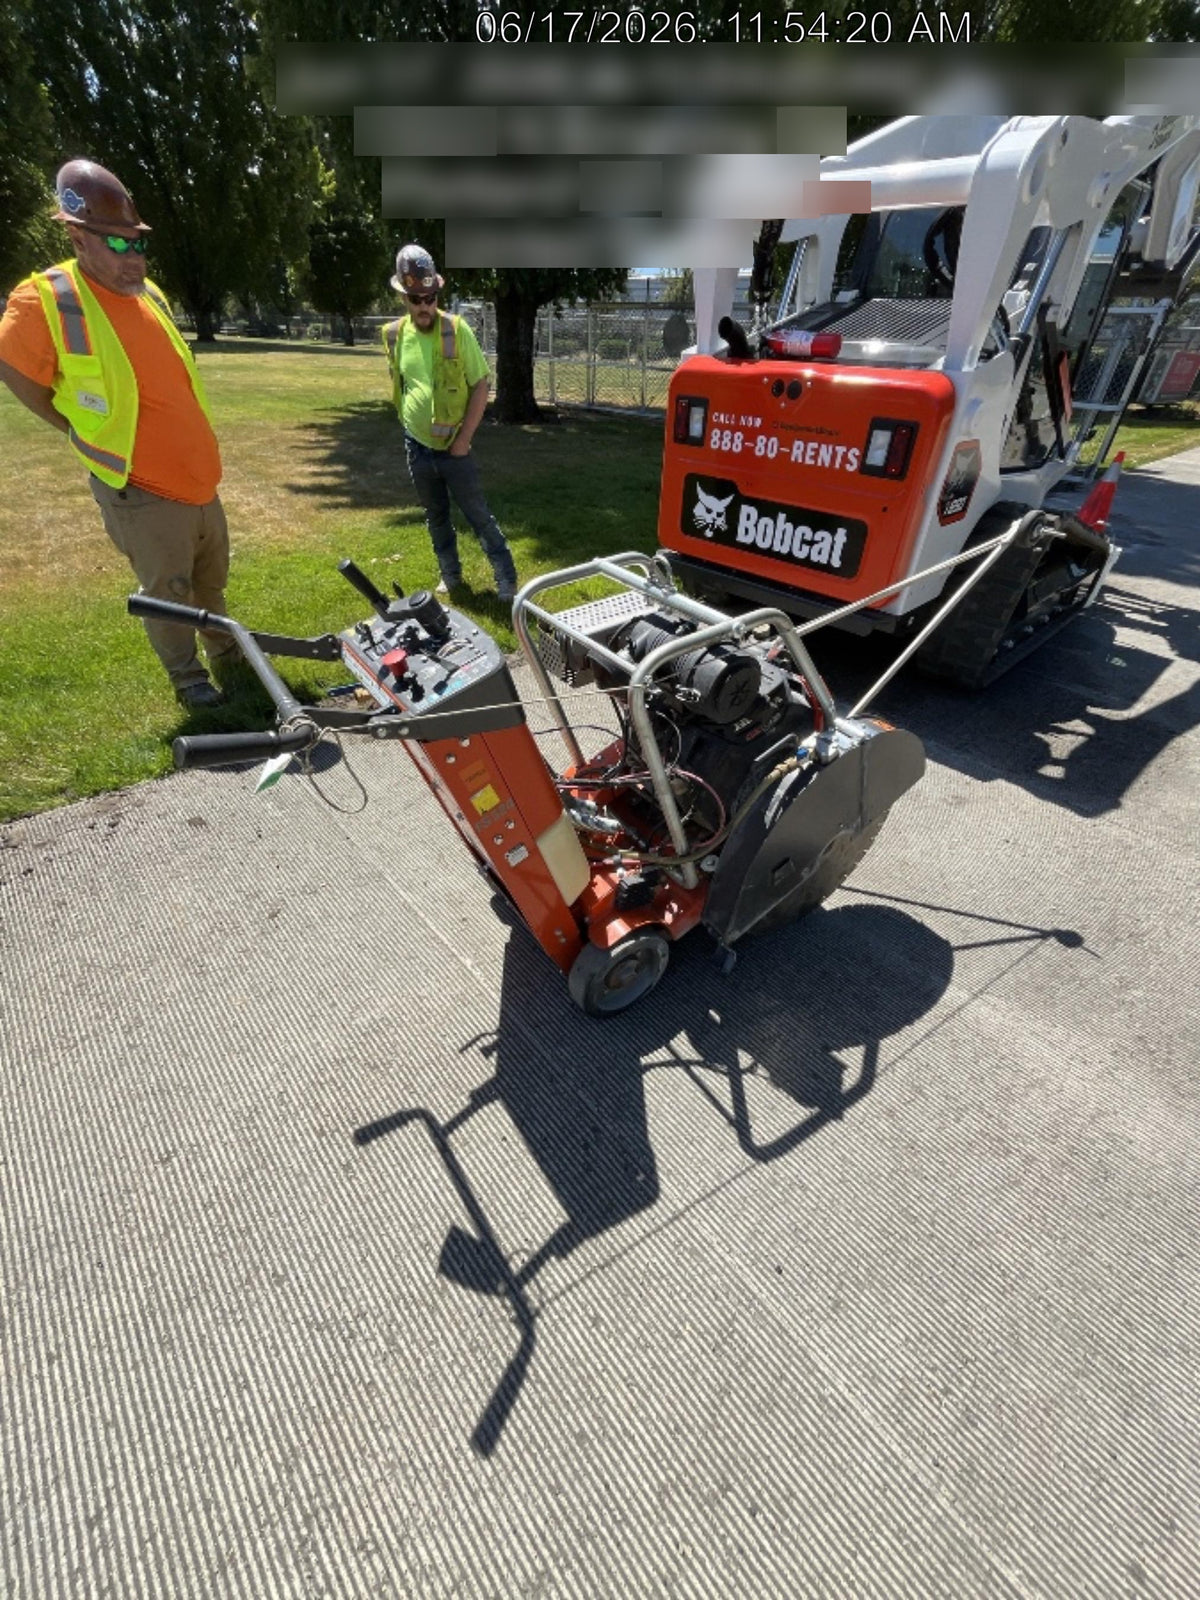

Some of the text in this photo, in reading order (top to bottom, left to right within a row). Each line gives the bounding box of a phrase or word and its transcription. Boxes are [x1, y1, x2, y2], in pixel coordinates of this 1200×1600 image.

[712, 412, 736, 424] CALL
[739, 415, 763, 428] NOW
[710, 428, 861, 472] 888-80-RENTS
[736, 504, 848, 568] Bobcat
